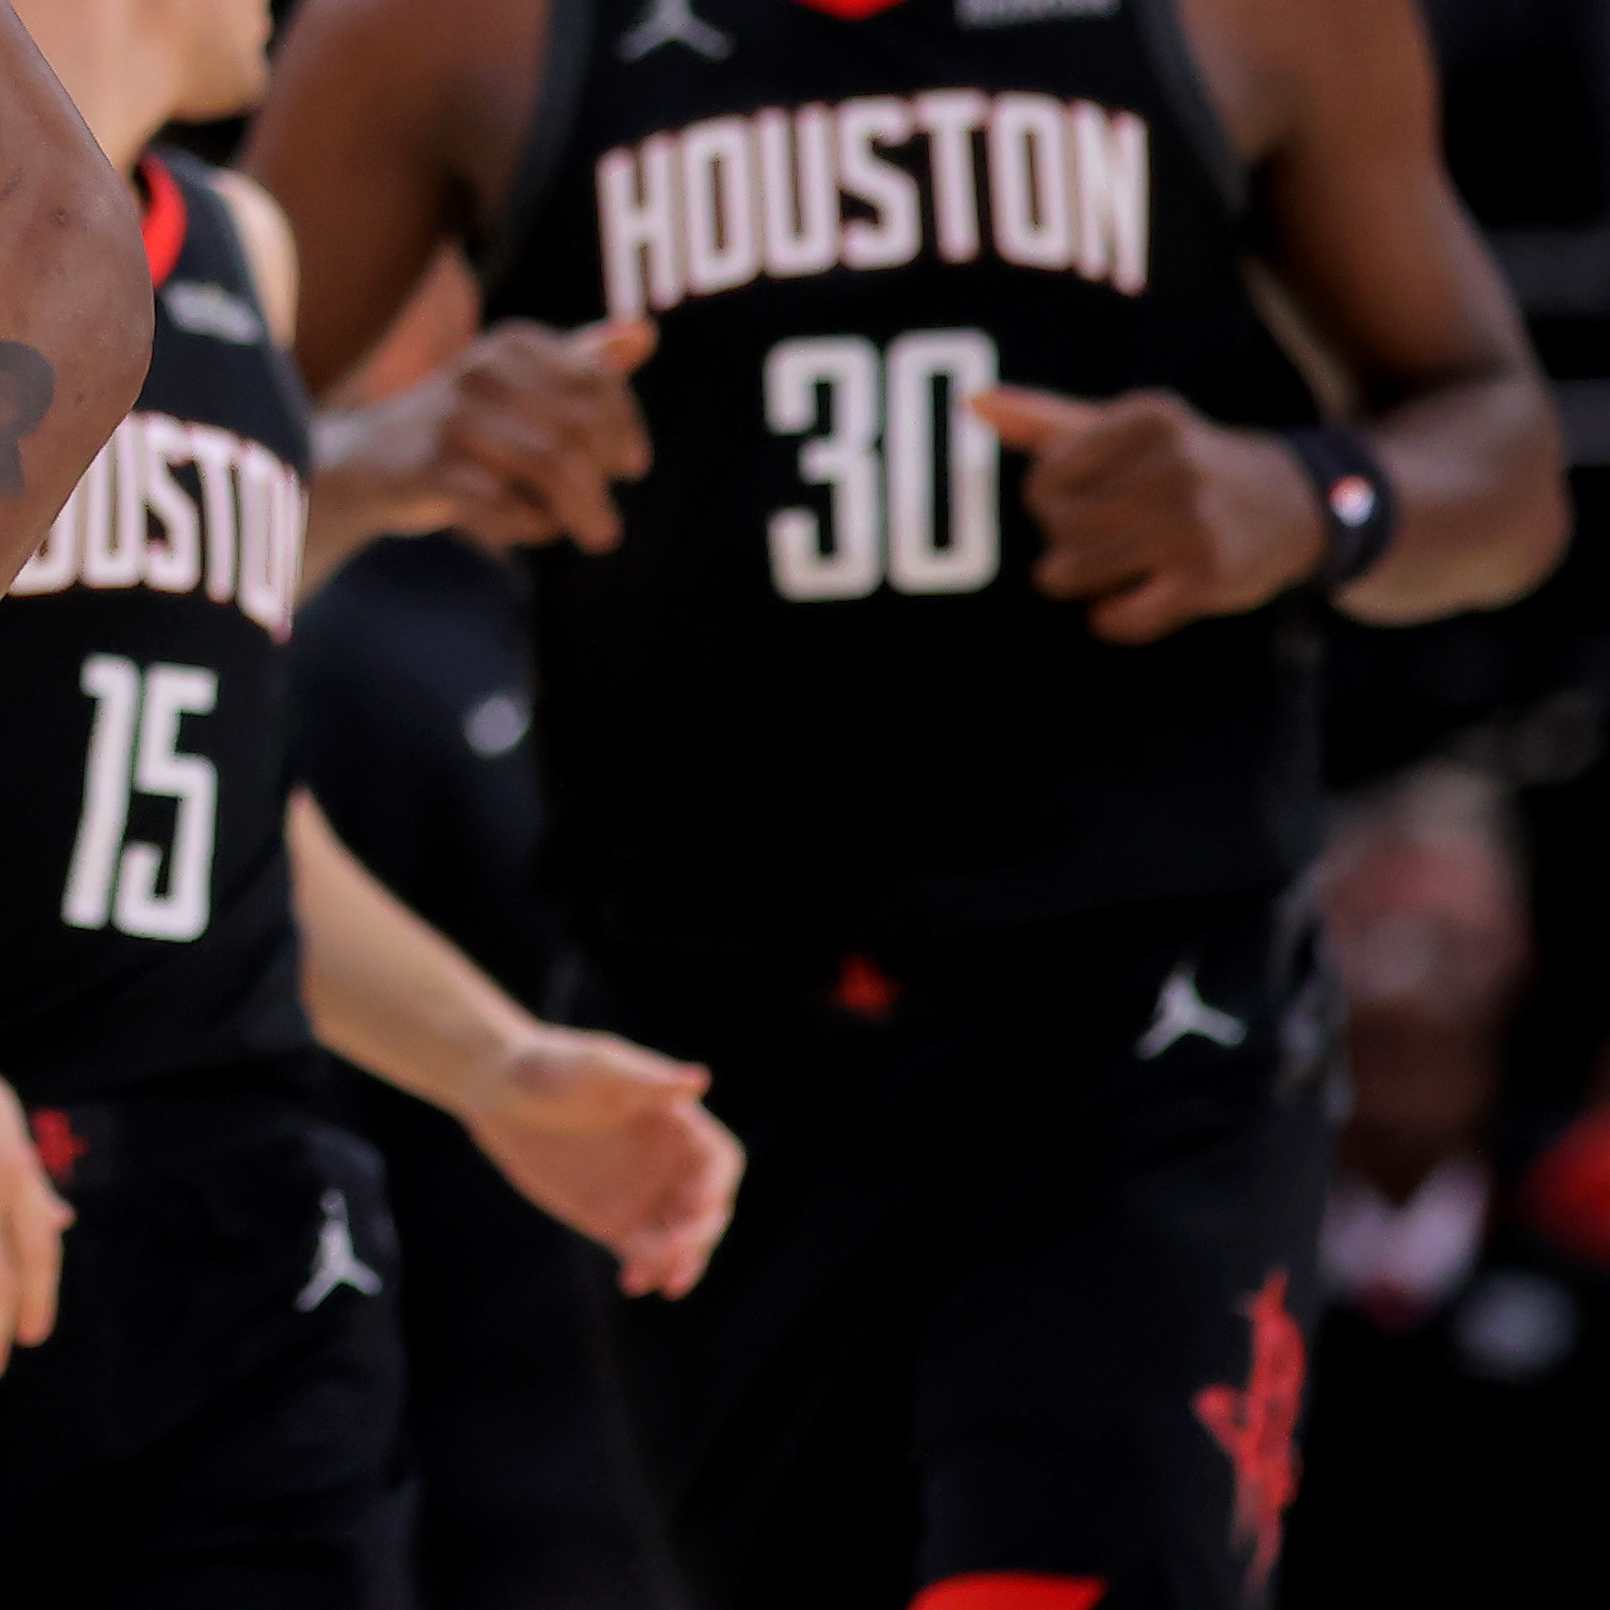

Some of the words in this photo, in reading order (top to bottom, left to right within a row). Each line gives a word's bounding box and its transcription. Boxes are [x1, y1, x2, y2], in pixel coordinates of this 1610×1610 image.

[595, 86, 1150, 320] HOUSTON
[763, 327, 1001, 602] 30
[61, 653, 220, 943] 15
